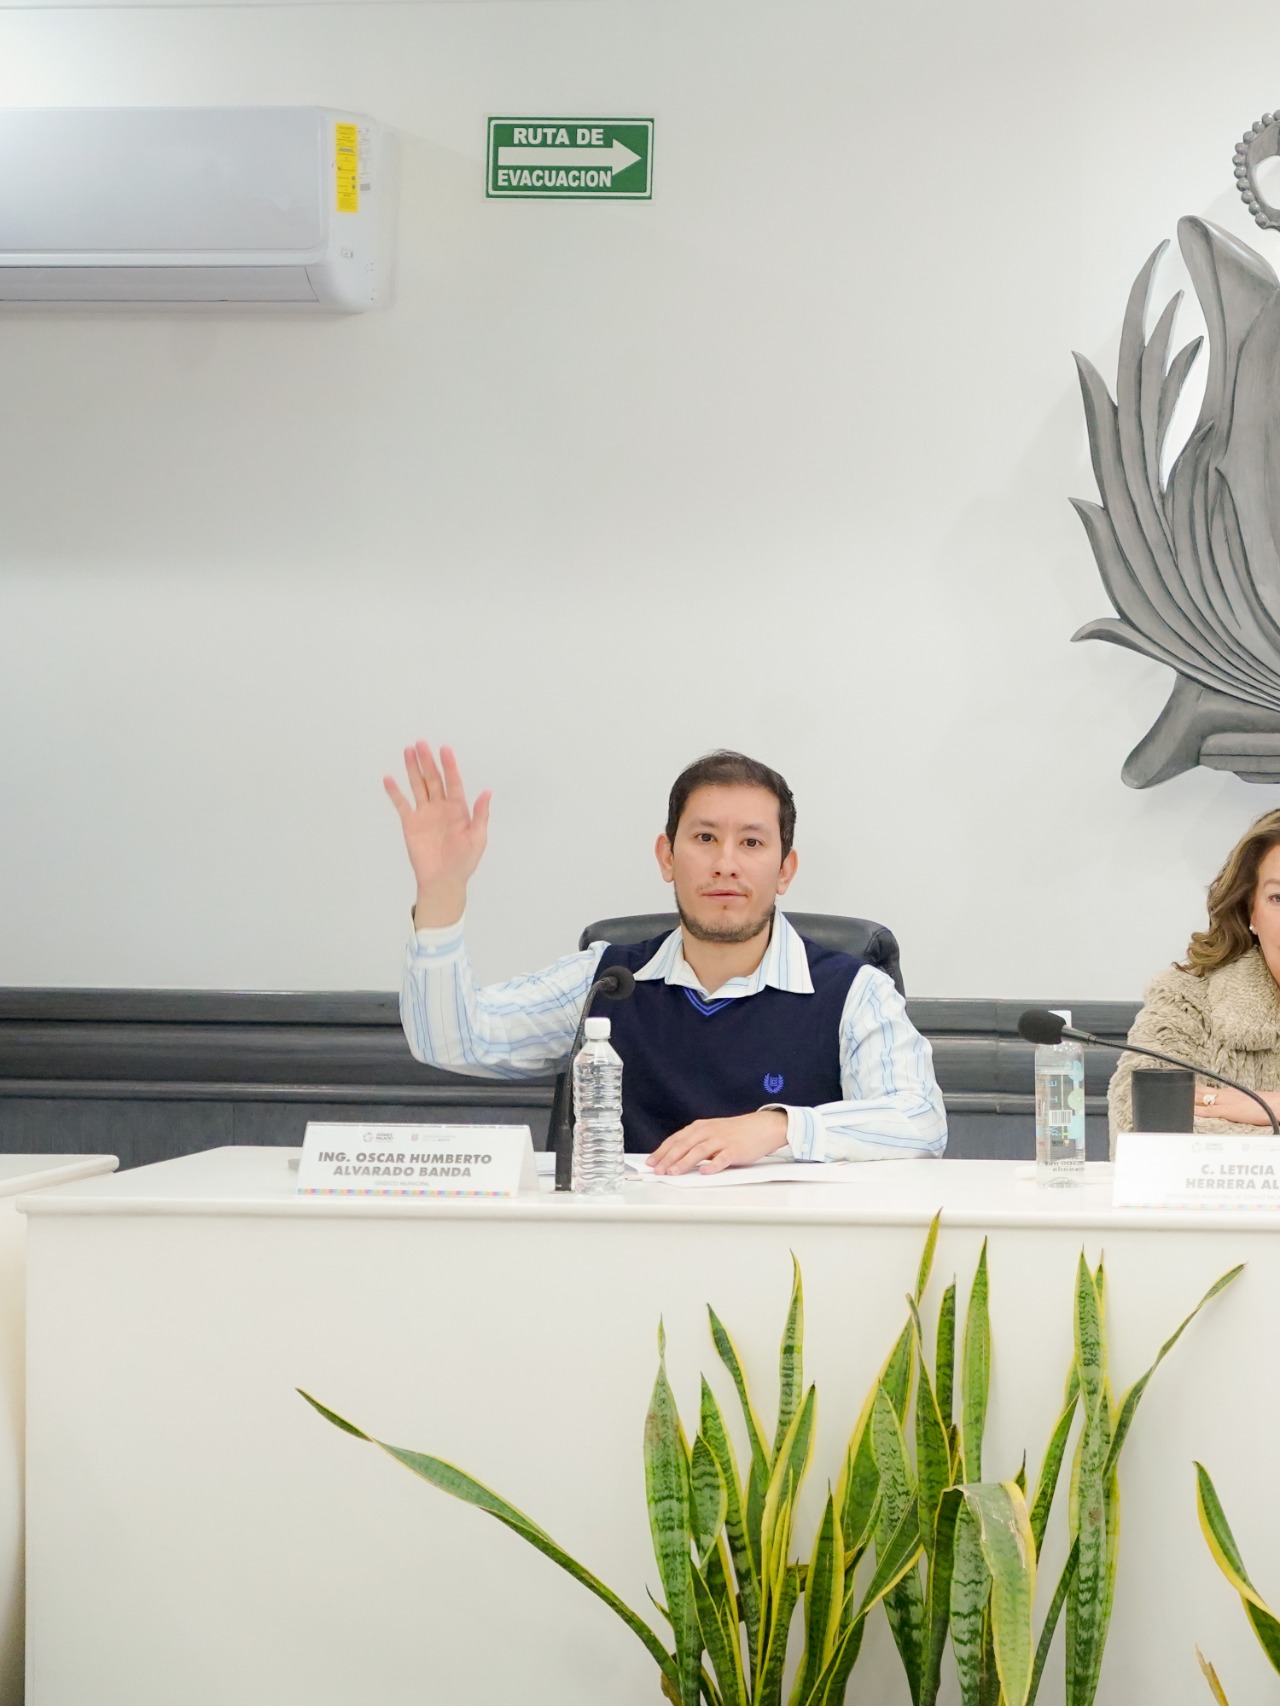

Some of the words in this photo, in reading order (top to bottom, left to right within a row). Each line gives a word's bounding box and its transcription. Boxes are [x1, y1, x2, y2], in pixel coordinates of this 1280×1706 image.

[513, 127, 570, 145] RUTA
[576, 128, 604, 145] DE
[497, 169, 612, 187] EVACUACION
[318, 1151, 351, 1163] ING.
[356, 1152, 405, 1164] OSCAR
[409, 1153, 492, 1165] HUMBERTO
[333, 1165, 415, 1177] ALVARADO
[419, 1166, 472, 1178] BANDA
[1200, 1164, 1215, 1176] C.
[1219, 1164, 1275, 1176] LETICIA
[1185, 1178, 1257, 1190] HERRERA
